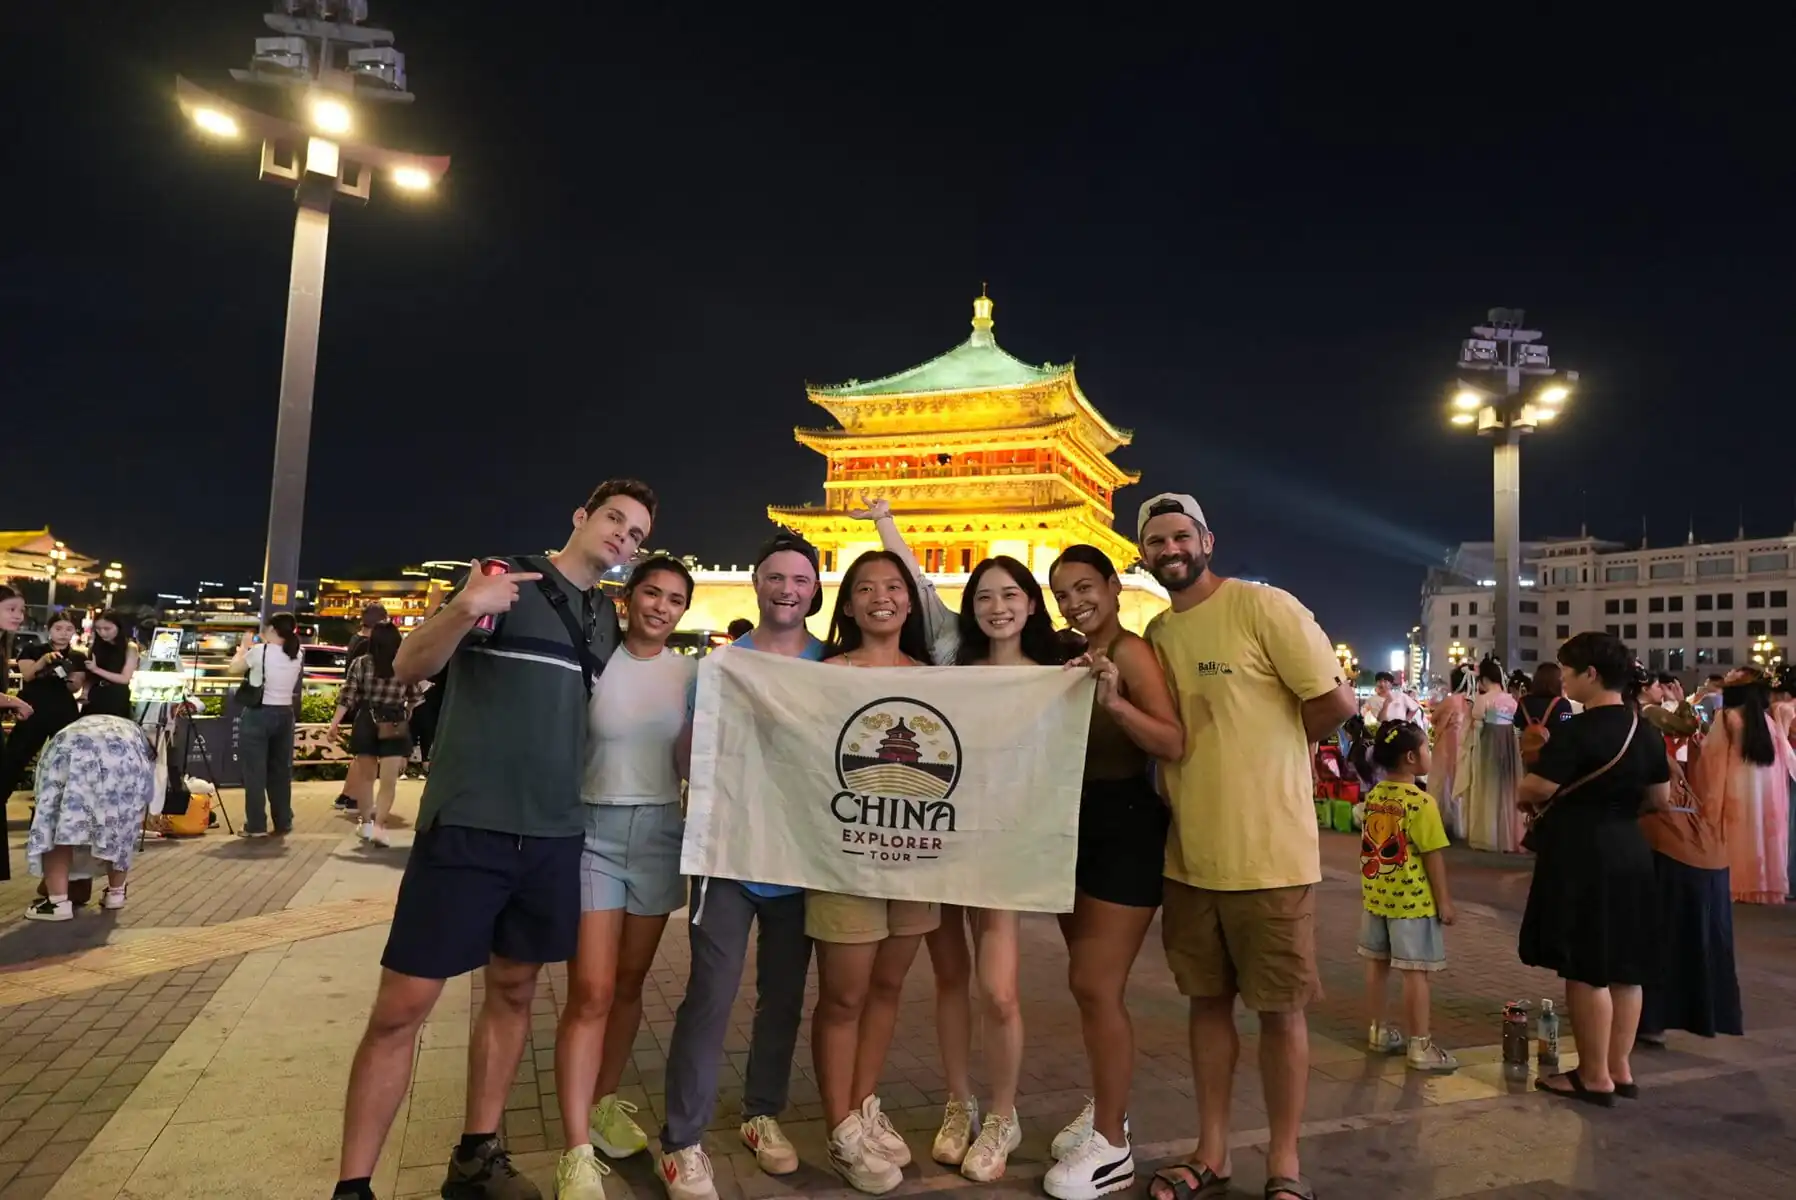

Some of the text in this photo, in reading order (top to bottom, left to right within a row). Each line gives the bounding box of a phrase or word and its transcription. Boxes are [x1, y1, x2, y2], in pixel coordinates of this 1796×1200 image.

[830, 790, 956, 832] CHINA
[842, 828, 943, 850] EXPLORER
[869, 850, 912, 862] TOUR
